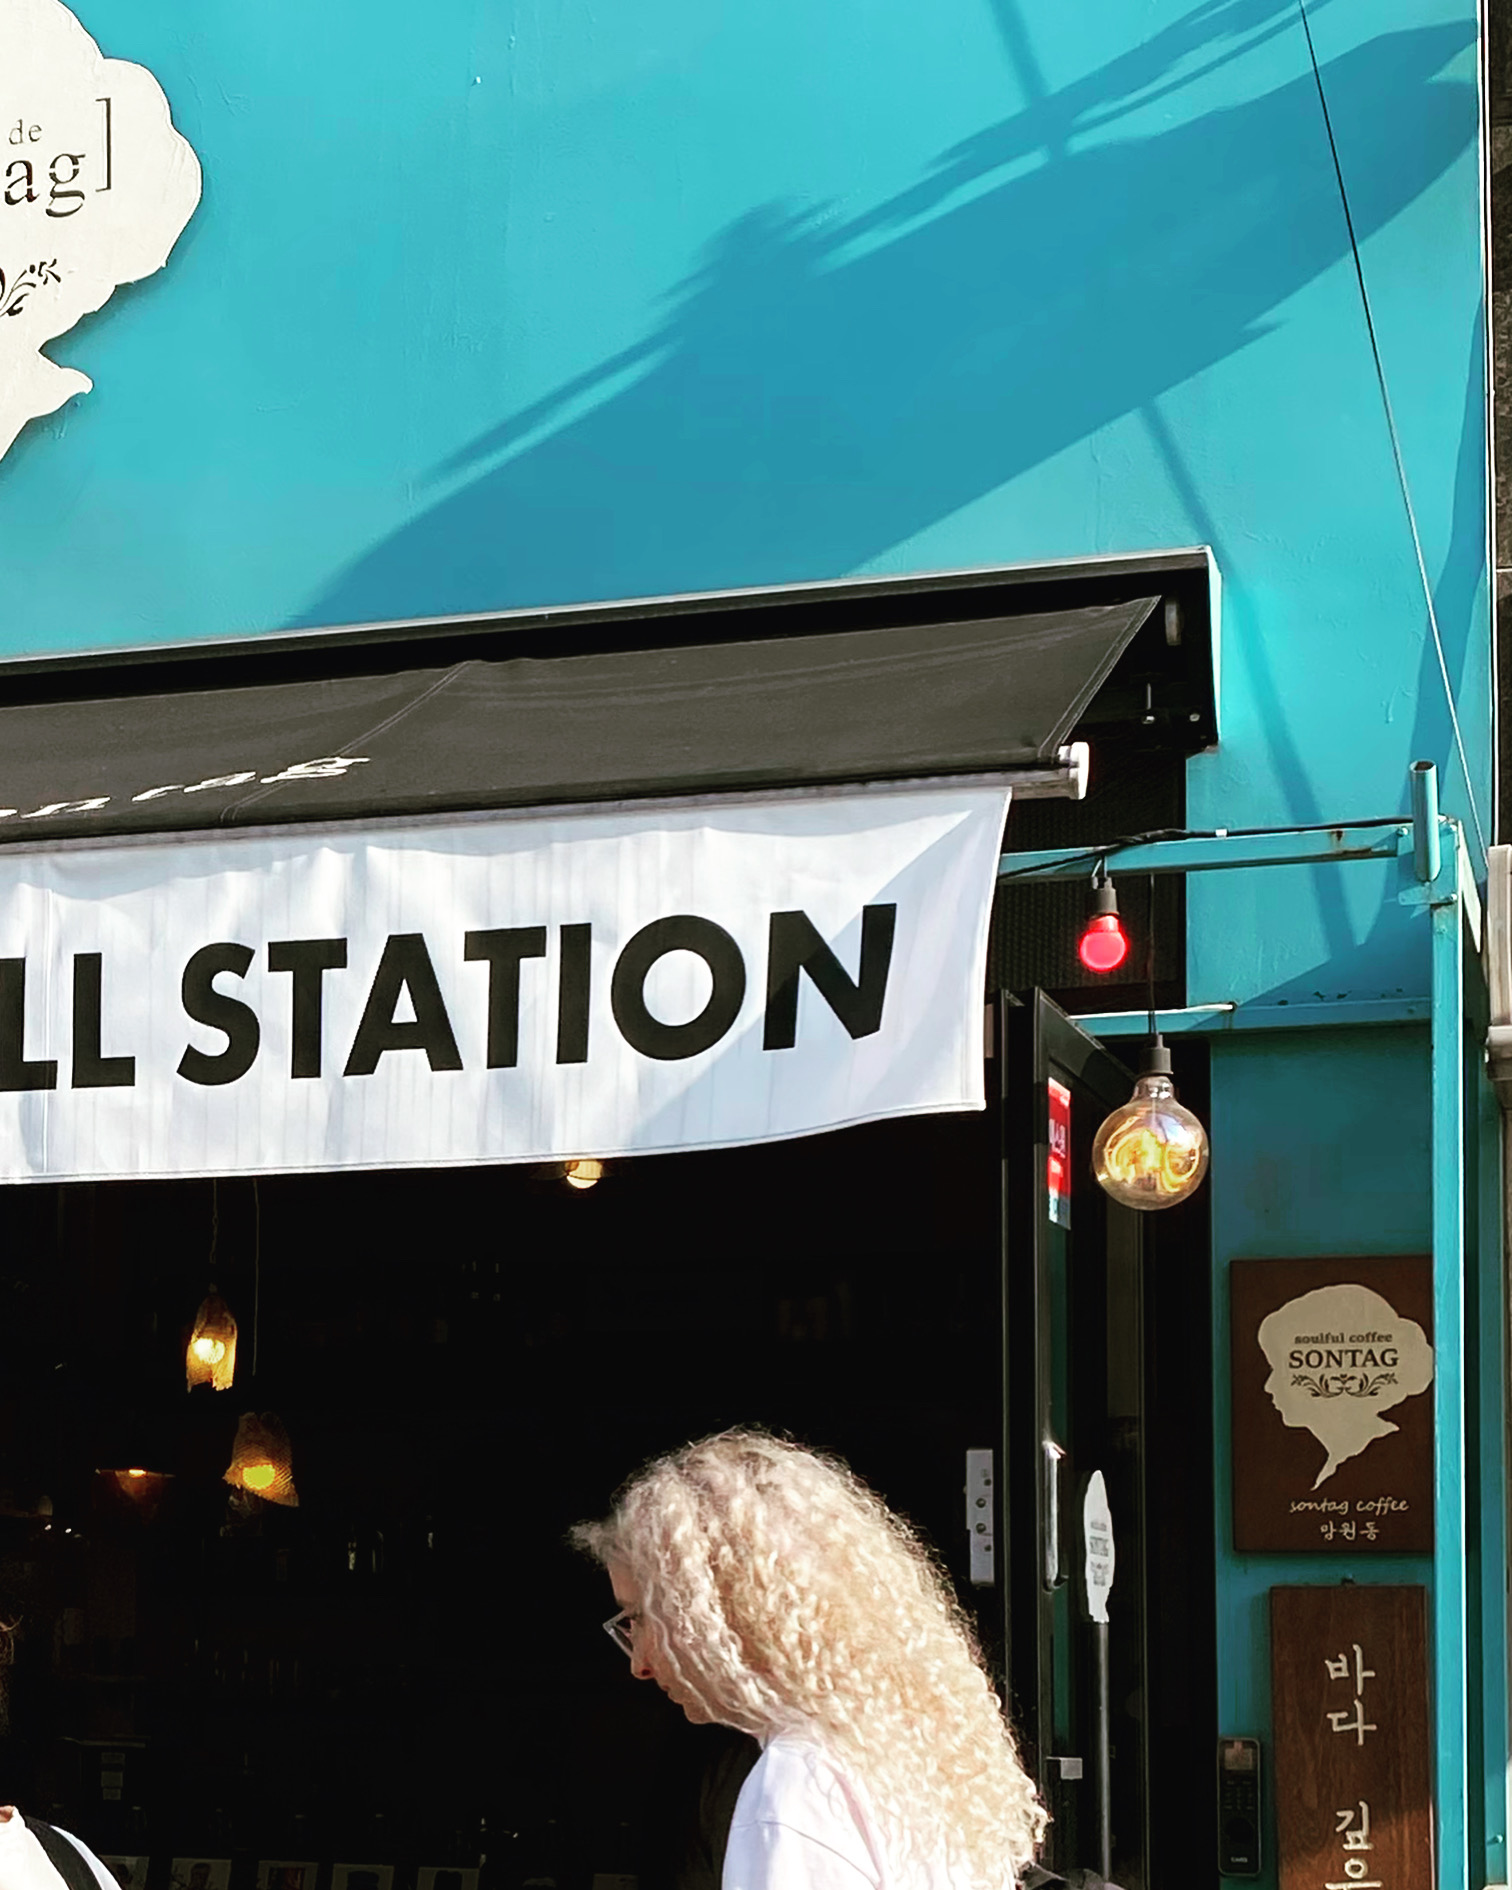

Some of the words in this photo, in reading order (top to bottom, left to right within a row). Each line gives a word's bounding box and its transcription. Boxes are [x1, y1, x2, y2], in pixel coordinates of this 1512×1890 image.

[8, 118, 43, 146] de
[176, 902, 897, 1086] STATION
[1294, 1331, 1345, 1345] soulful
[1348, 1331, 1393, 1344] coffee
[1288, 1347, 1400, 1370] SONTAG
[1289, 1499, 1349, 1515] sontag
[1356, 1496, 1410, 1516] coffee
[1324, 1643, 1377, 1747] 바다
